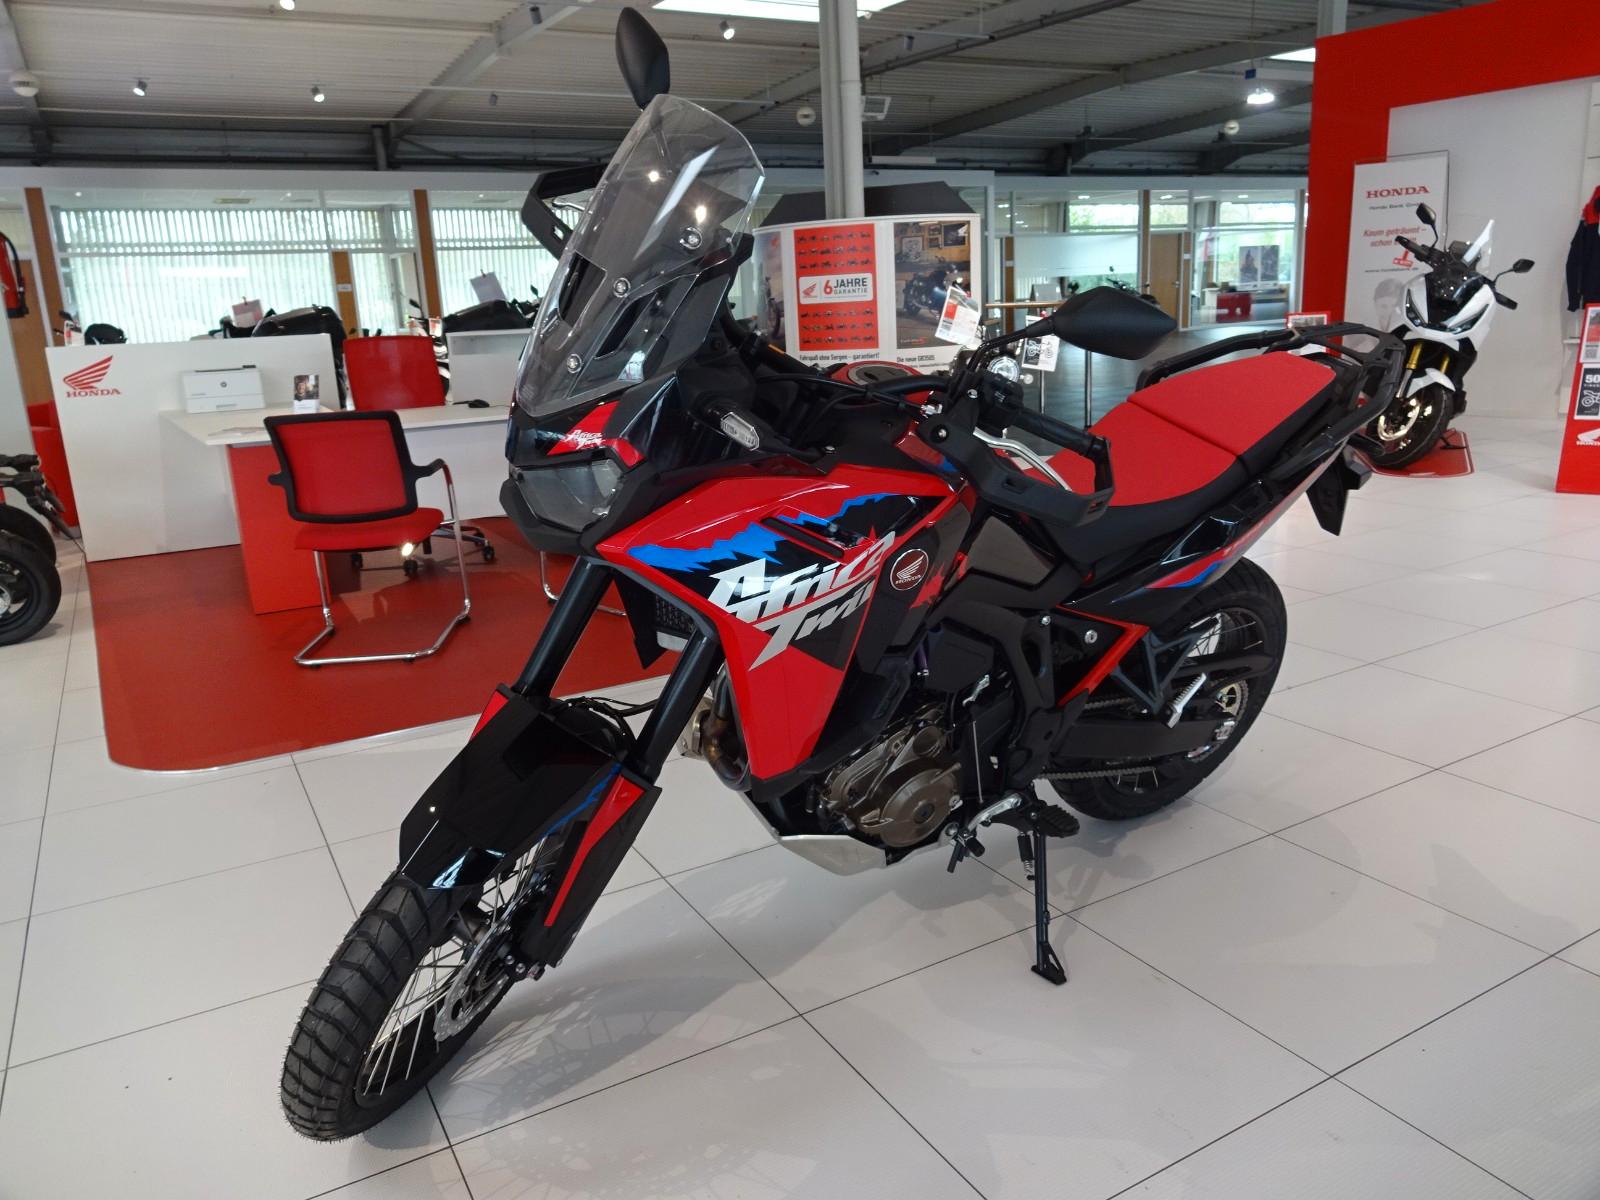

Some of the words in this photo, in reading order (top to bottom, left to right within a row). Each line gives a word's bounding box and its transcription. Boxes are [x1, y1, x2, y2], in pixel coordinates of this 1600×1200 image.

[1366, 186, 1430, 199] HONDA
[823, 280, 833, 295] 6
[834, 277, 868, 289] JAHRE
[834, 287, 868, 295] GARANTIE
[65, 388, 121, 398] HONDA
[895, 575, 922, 585] HONDA
